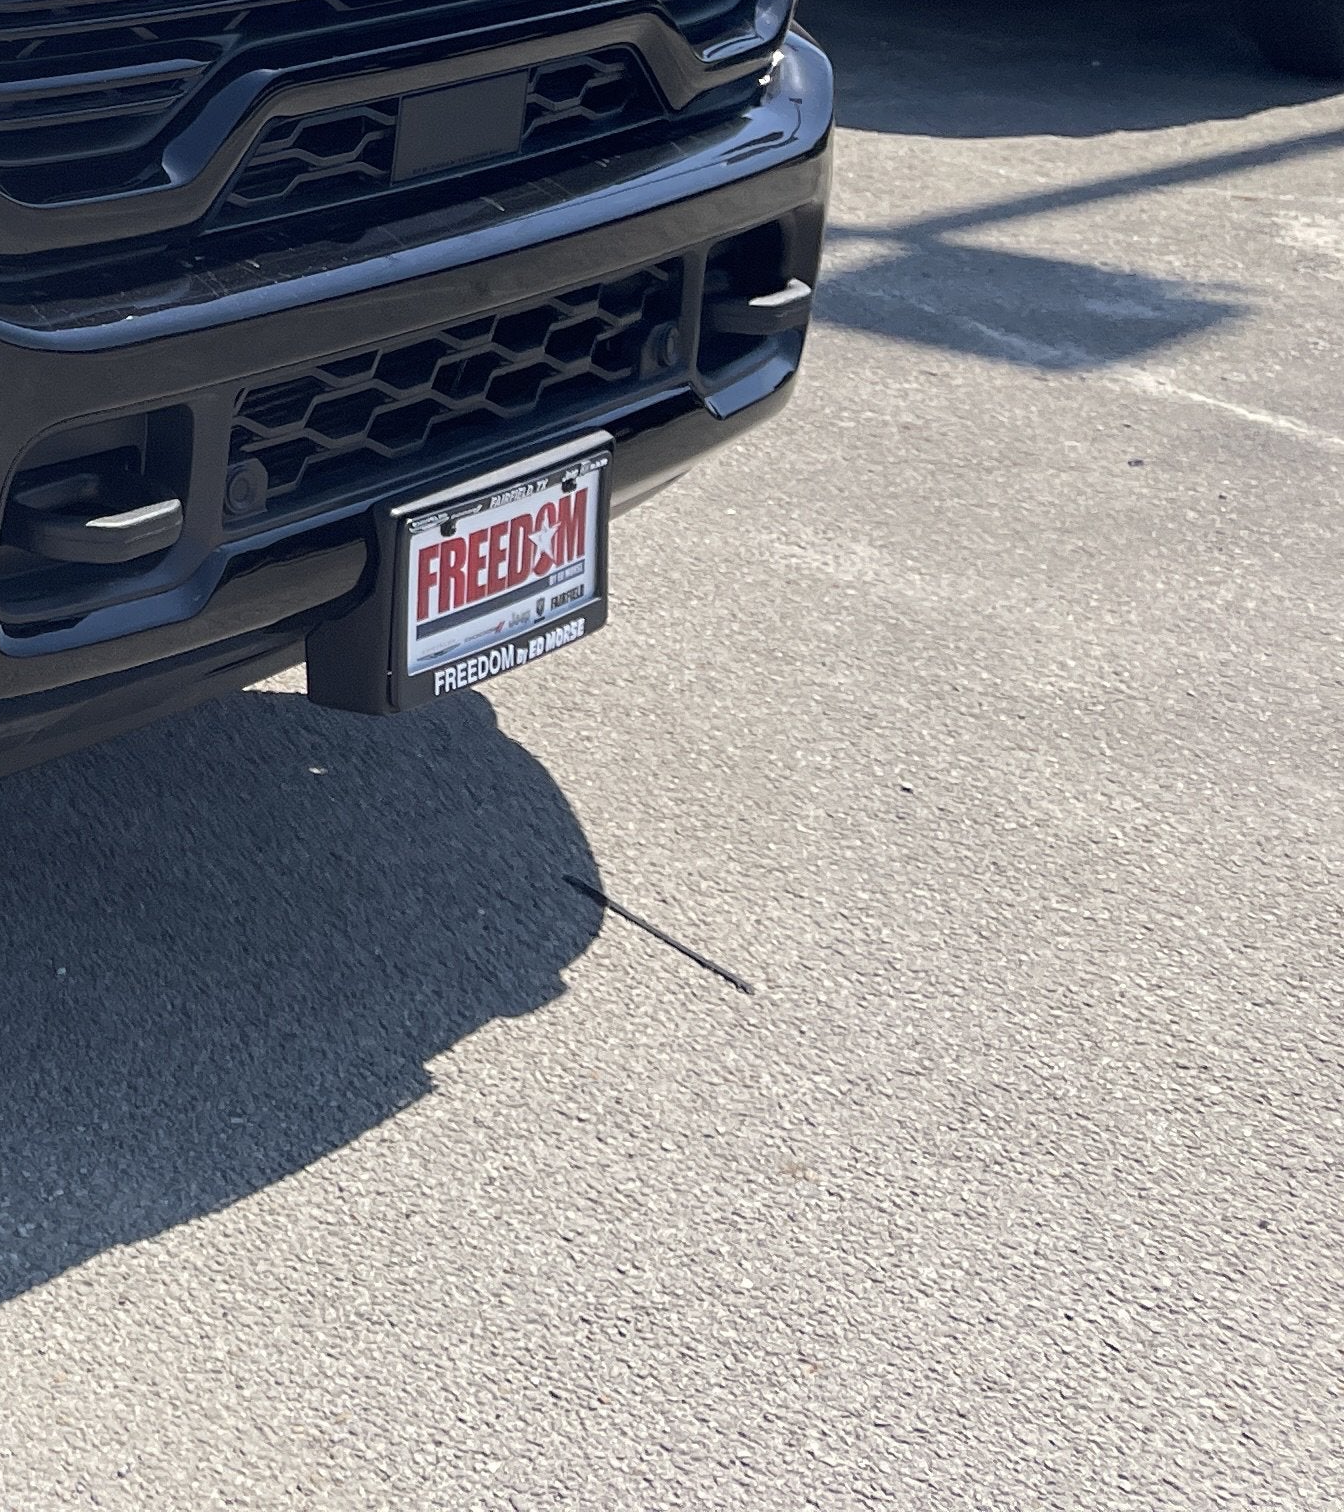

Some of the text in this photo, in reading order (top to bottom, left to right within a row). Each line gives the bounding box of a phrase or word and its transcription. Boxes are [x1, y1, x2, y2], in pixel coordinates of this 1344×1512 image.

[417, 488, 587, 621] FREEDOM
[434, 644, 514, 696] FREEDOM
[529, 635, 544, 660] ED
[545, 617, 586, 652] MORSE
